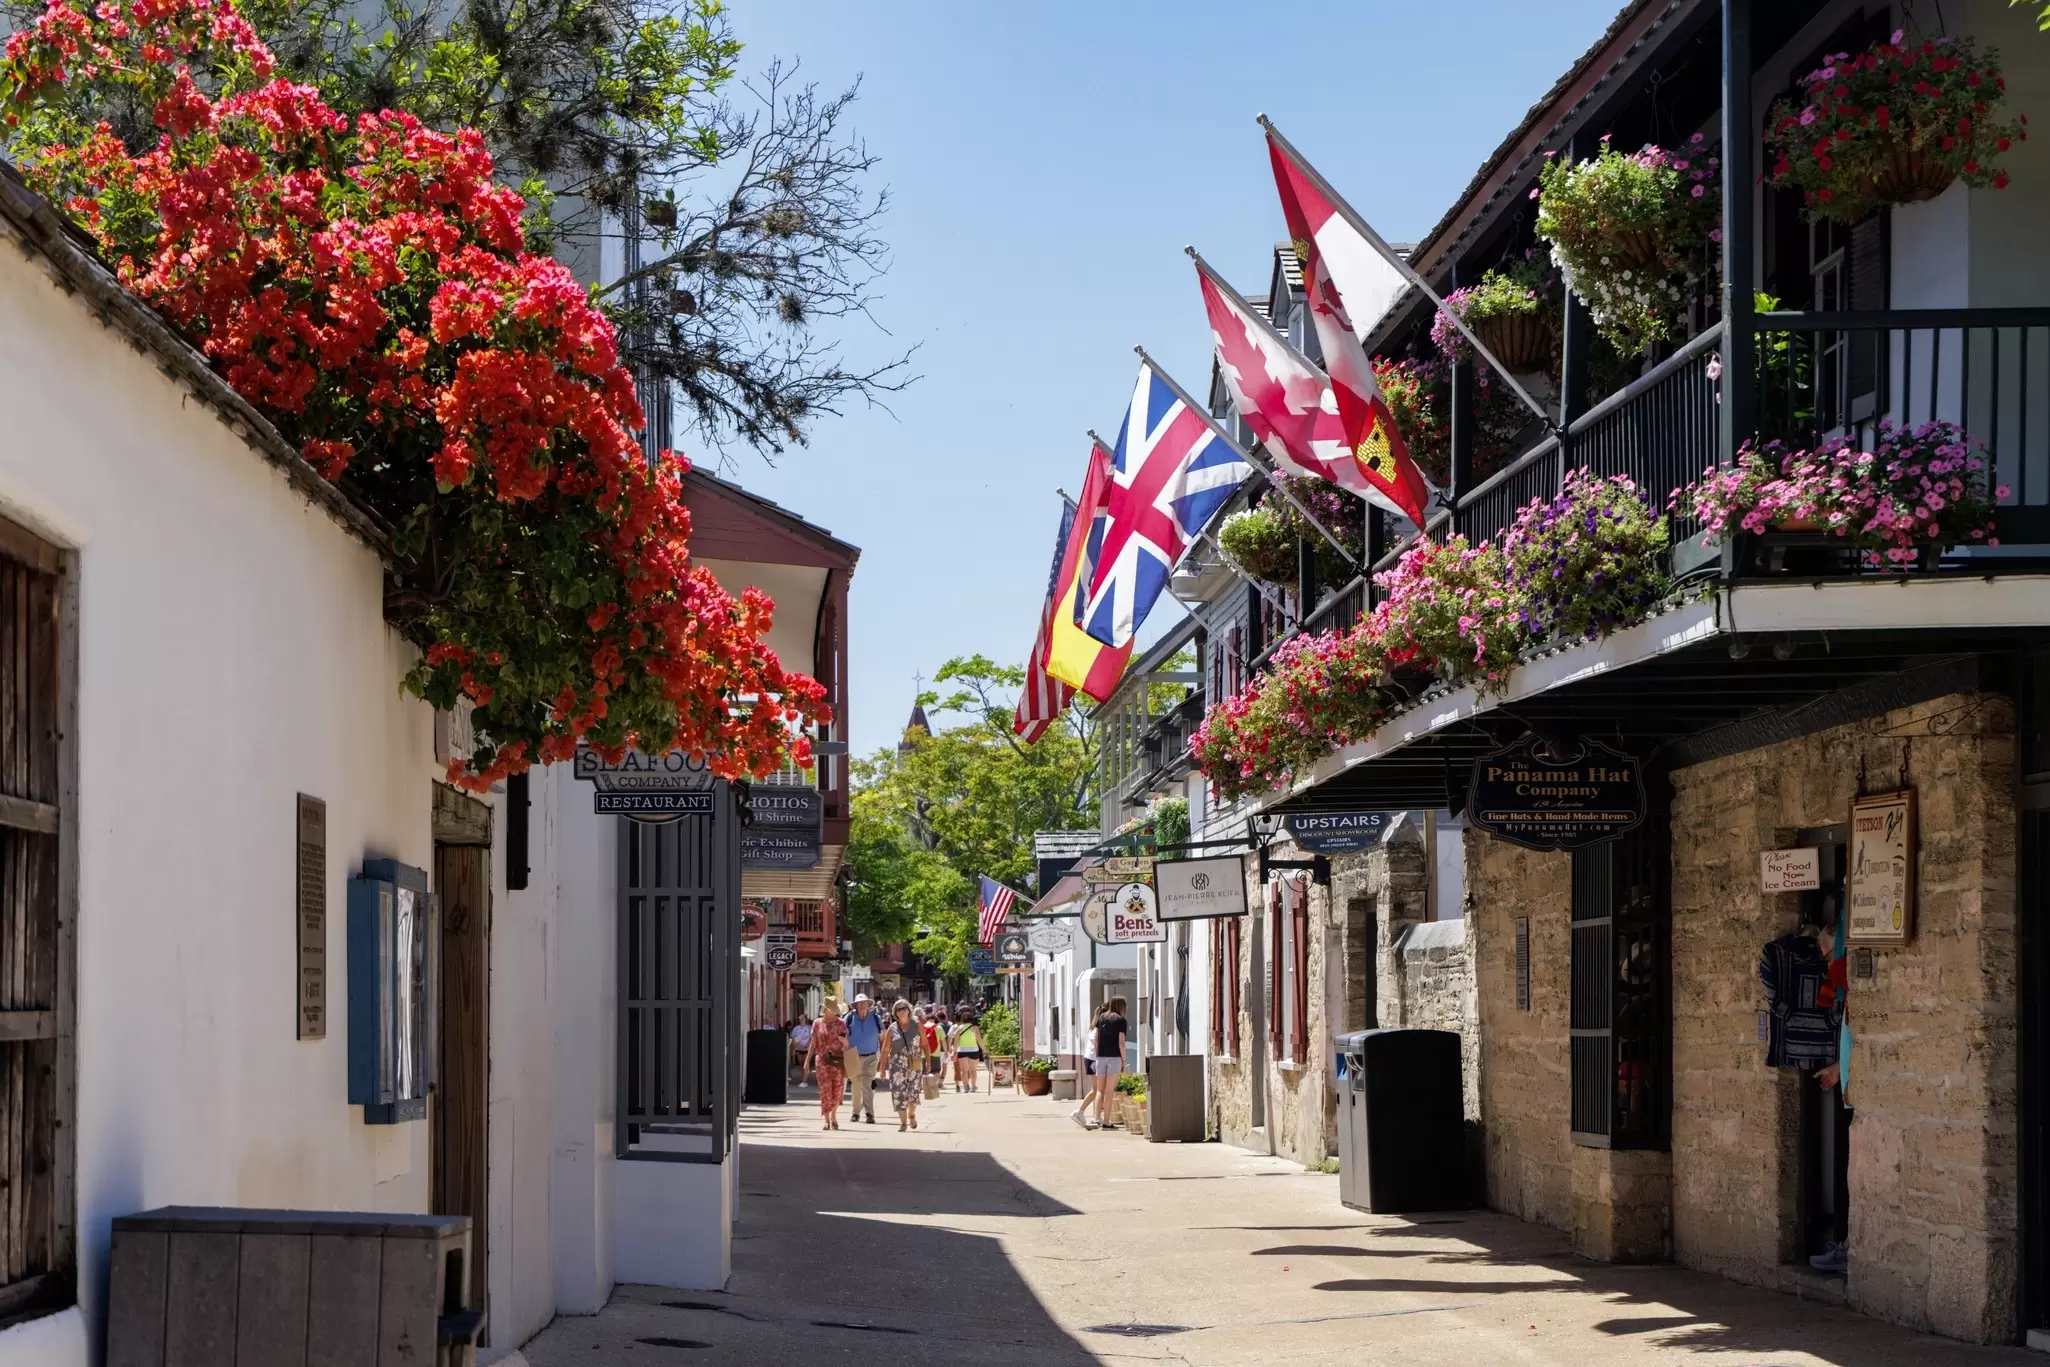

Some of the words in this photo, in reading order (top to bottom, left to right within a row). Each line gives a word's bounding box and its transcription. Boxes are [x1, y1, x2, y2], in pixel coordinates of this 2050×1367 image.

[1510, 761, 1529, 769] The
[1487, 767, 1580, 782] Panama
[1588, 767, 1630, 782] Hat
[618, 777, 691, 787] COMPANY
[1515, 784, 1601, 798] Company
[600, 796, 710, 808] RESTAURANT
[766, 811, 803, 822] Shrine
[1295, 815, 1380, 829] UPSTAIRS
[1488, 812, 1508, 821] Fine
[1510, 812, 1532, 821] Hats
[1534, 812, 1543, 821] &
[1601, 812, 1628, 821] Items
[1856, 816, 1883, 832] STETSON
[760, 838, 808, 847] Exhibits
[763, 849, 793, 861] Shop
[1768, 864, 1782, 872] No
[1786, 861, 1811, 871] Food
[1765, 881, 1779, 889] Ice
[1783, 880, 1816, 888] Cream
[1163, 891, 1216, 902] JEAN-PIERRE
[1217, 890, 1240, 898] KLIFA
[1115, 929, 1129, 937] soft
[1131, 928, 1160, 938] pretzels
[768, 952, 794, 960] LEGACY
